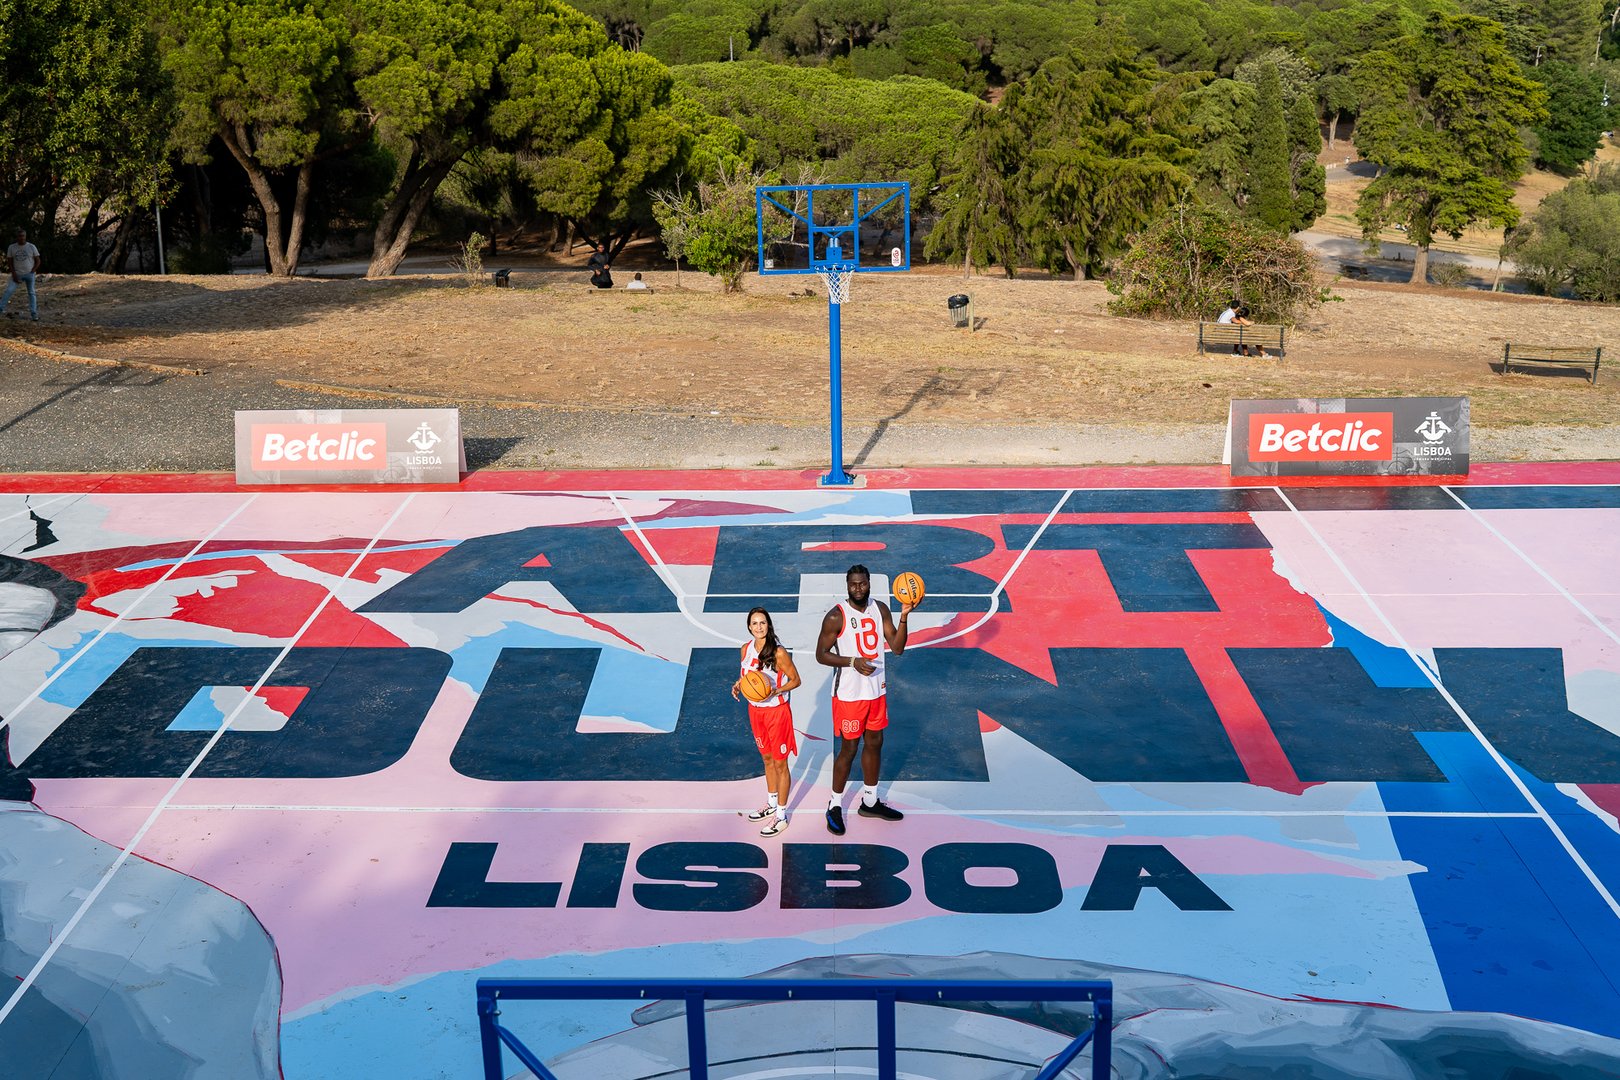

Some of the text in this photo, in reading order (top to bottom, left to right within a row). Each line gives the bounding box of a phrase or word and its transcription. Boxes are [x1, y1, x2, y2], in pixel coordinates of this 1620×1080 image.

[261, 430, 376, 461] Betclic
[1259, 420, 1382, 452] Betclic
[1413, 447, 1452, 456] LISBOA
[406, 456, 442, 465] LISBOA
[351, 523, 1273, 614] ART
[425, 841, 1234, 914] LISBOA
